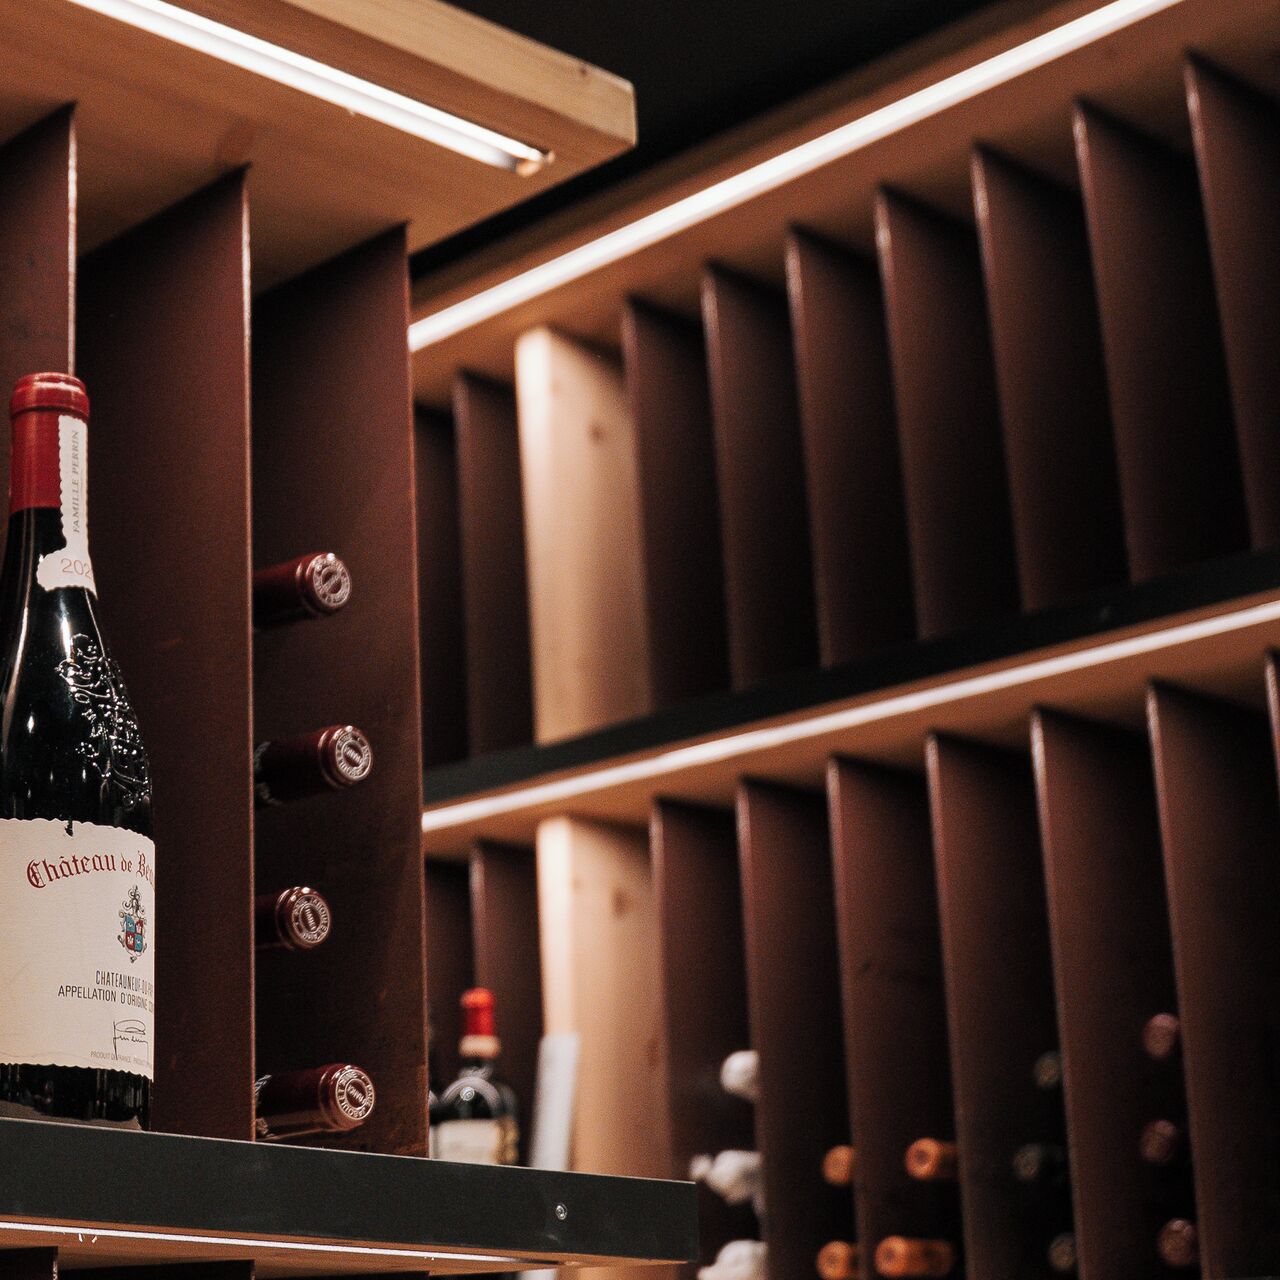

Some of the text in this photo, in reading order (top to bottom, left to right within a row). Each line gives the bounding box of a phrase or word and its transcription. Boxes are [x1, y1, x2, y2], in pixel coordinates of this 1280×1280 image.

[70, 430, 80, 534] FAMILLE PERRIN
[60, 557, 93, 580] 202
[26, 853, 117, 889] Château
[120, 851, 133, 873] de
[57, 984, 117, 1003] APPELLATION
[95, 969, 154, 998] CHATEAUNEUF-DU-P
